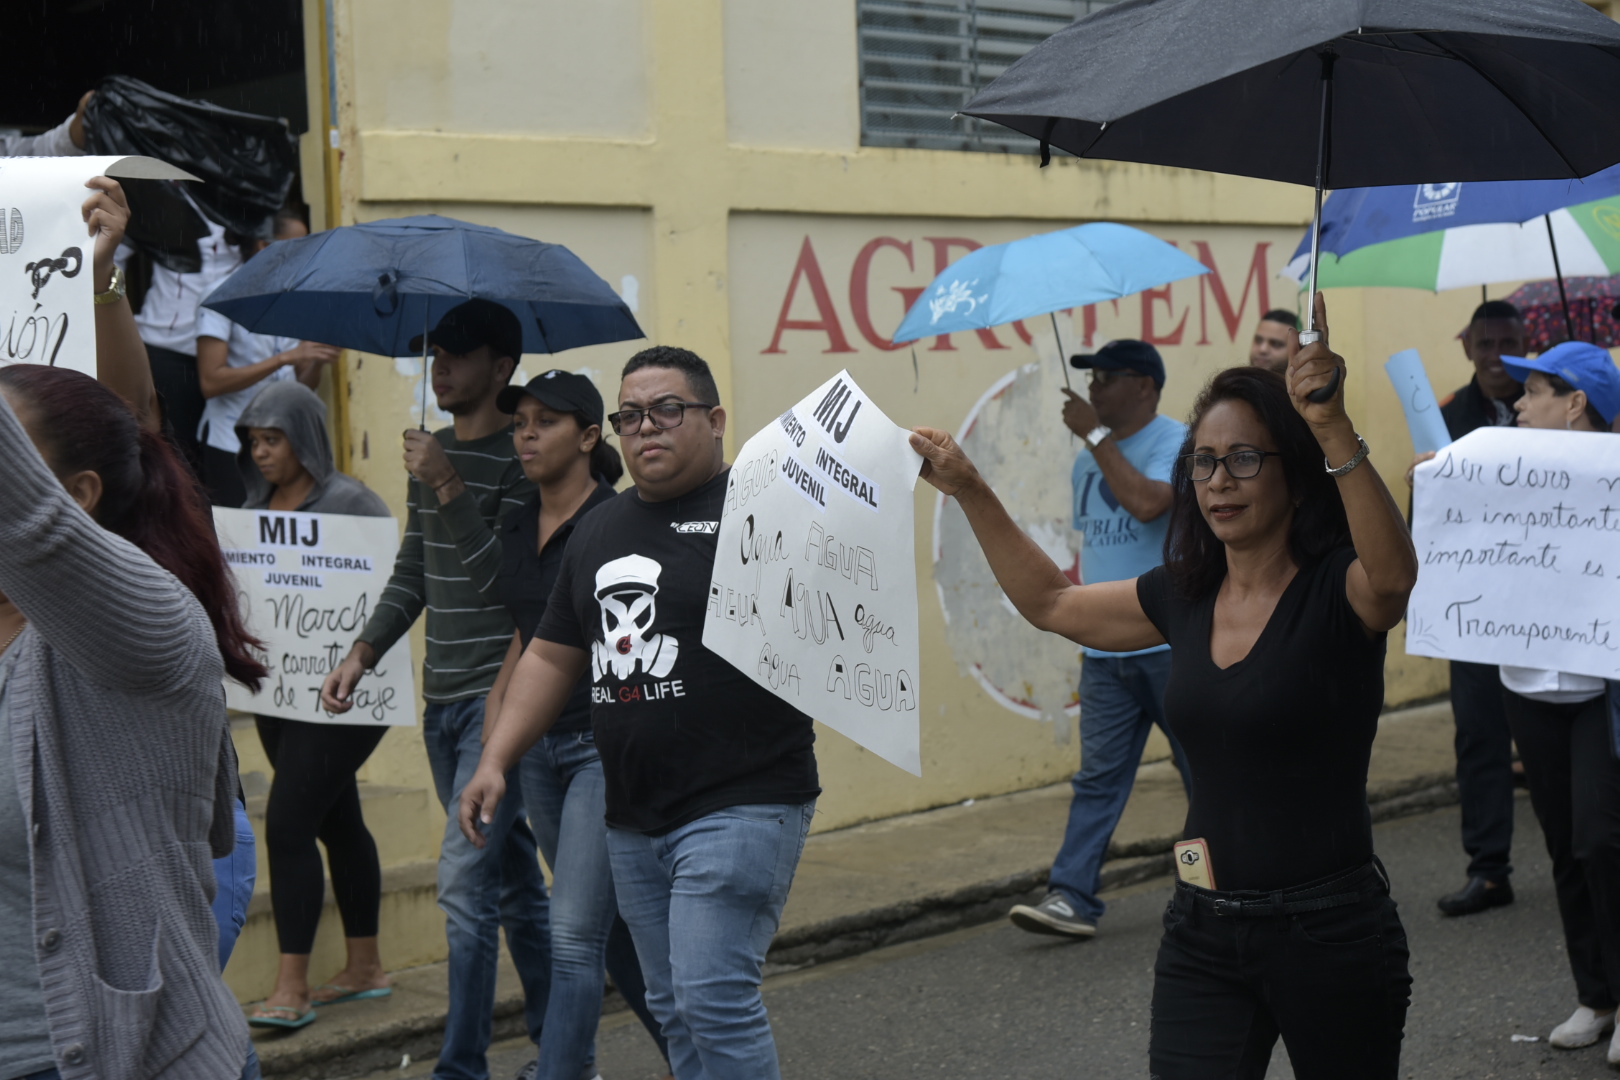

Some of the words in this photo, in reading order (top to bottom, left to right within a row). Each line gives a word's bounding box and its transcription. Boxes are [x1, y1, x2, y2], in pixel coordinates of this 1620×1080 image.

[813, 378, 863, 444] MIJ
[782, 455, 826, 508] JUVENIL
[815, 446, 878, 509] INTEGRAL
[259, 515, 320, 547] MIJ
[804, 520, 879, 591] AGUA
[1424, 539, 1562, 573] importante
[265, 572, 322, 587] JUVENIL
[302, 555, 372, 571] INTEGRAL
[1445, 594, 1619, 650] Transparente
[592, 686, 616, 703] REAL
[619, 685, 641, 703] G4
[643, 679, 686, 701] LIFE
[826, 654, 916, 713] AGUA
